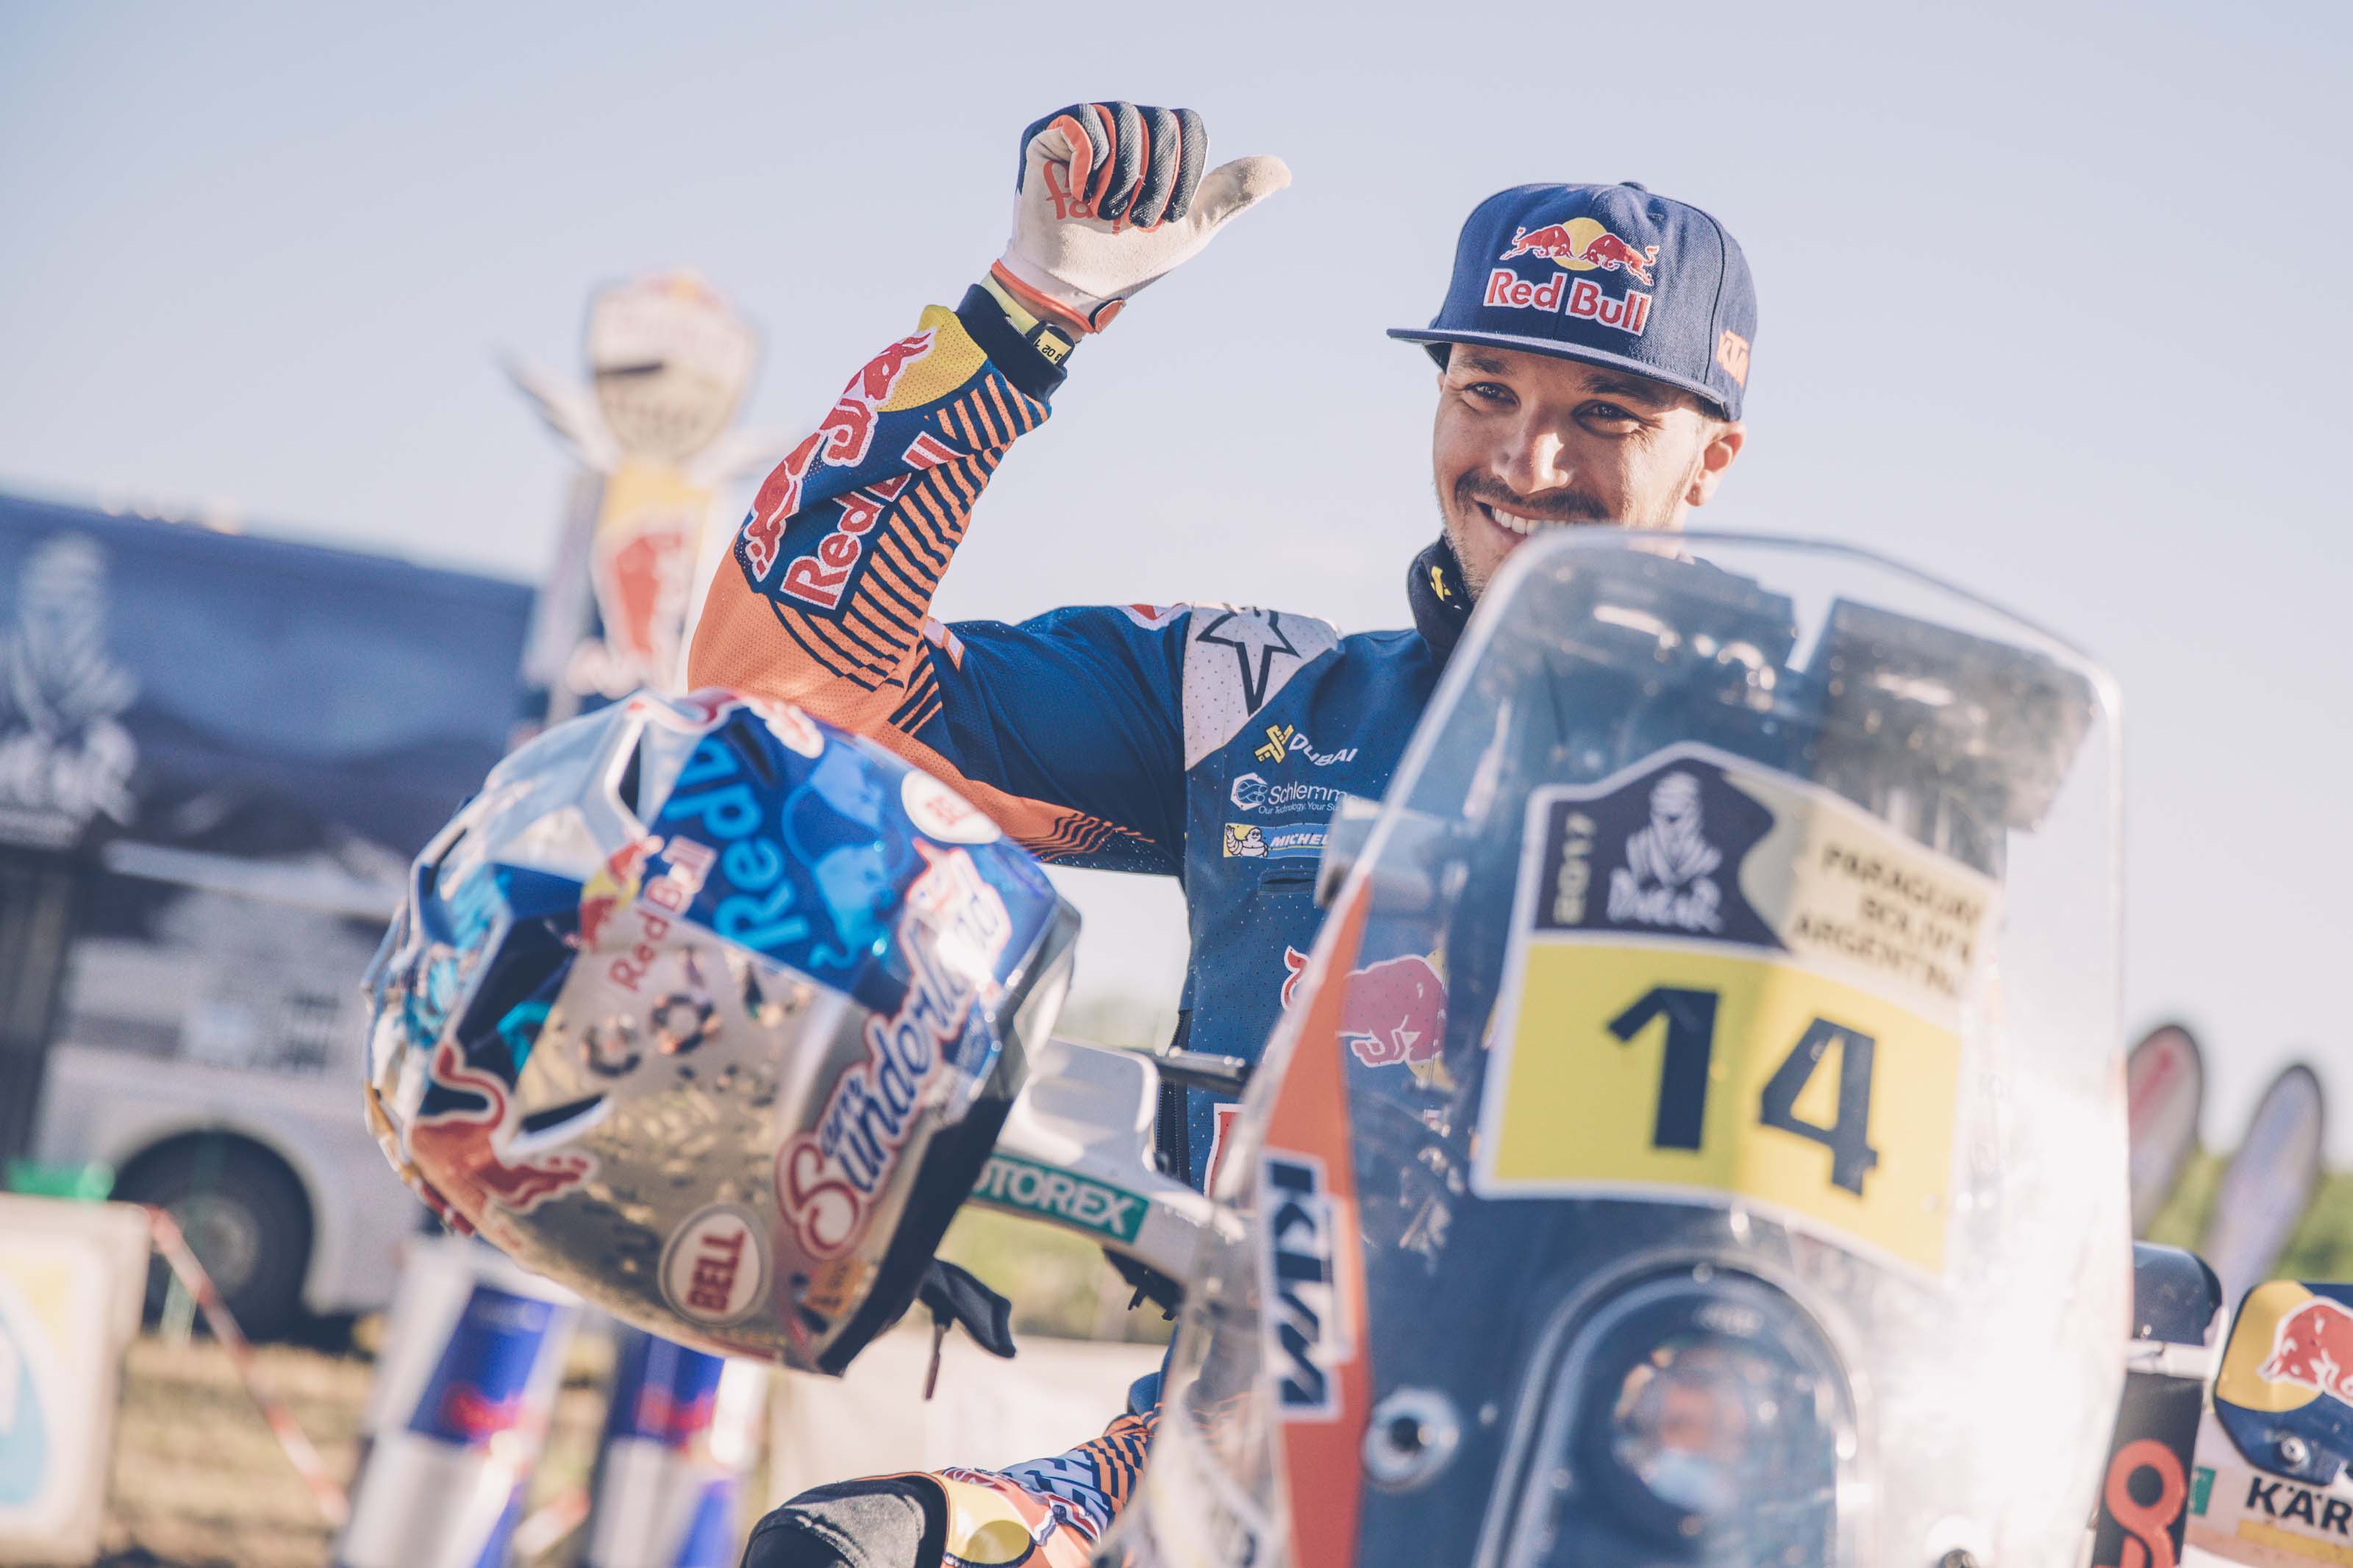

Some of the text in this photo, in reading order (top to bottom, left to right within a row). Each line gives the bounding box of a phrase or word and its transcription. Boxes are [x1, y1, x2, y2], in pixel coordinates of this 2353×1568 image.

[1485, 268, 1652, 336] Red Bull
[1042, 344, 1056, 357] 02
[1717, 329, 1749, 388] KTM
[780, 493, 885, 609] Red
[1288, 733, 1358, 767] DUBAI
[1258, 805, 1273, 815] Our
[1307, 801, 1325, 812] Your
[1268, 781, 1359, 805] Schlemm
[661, 781, 810, 951] Red
[1271, 833, 1331, 847] MICHEL
[608, 906, 671, 994] Red
[781, 859, 1006, 1253] Sunderlnd
[1605, 983, 1879, 1198] 14
[974, 1161, 1137, 1237] TOREX
[685, 1228, 746, 1314] BELL
[1269, 1161, 1332, 1404] KTM
